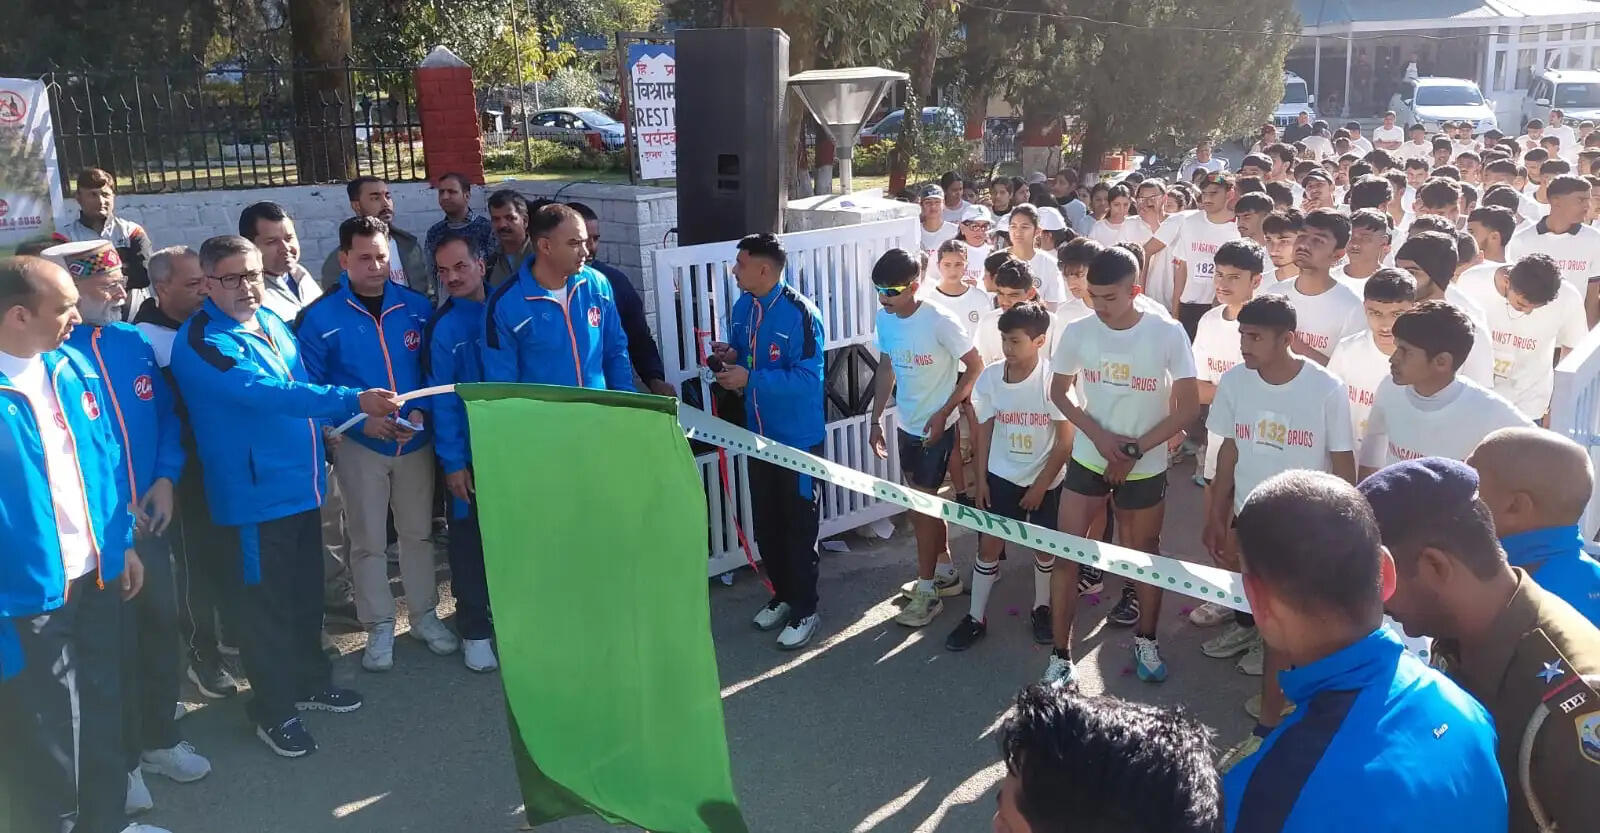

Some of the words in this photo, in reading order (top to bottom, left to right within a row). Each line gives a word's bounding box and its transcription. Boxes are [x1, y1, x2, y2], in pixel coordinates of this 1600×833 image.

[636, 107, 669, 128] REST
[1195, 262, 1215, 274] 182
[1513, 335, 1537, 350] DRUGS
[1131, 376, 1157, 392] DRUGS
[1029, 412, 1051, 426] DRUGS
[1235, 423, 1251, 440] RUN
[1287, 429, 1314, 448] DRUGS
[1258, 419, 1287, 445] 132
[1009, 432, 1033, 449] 116
